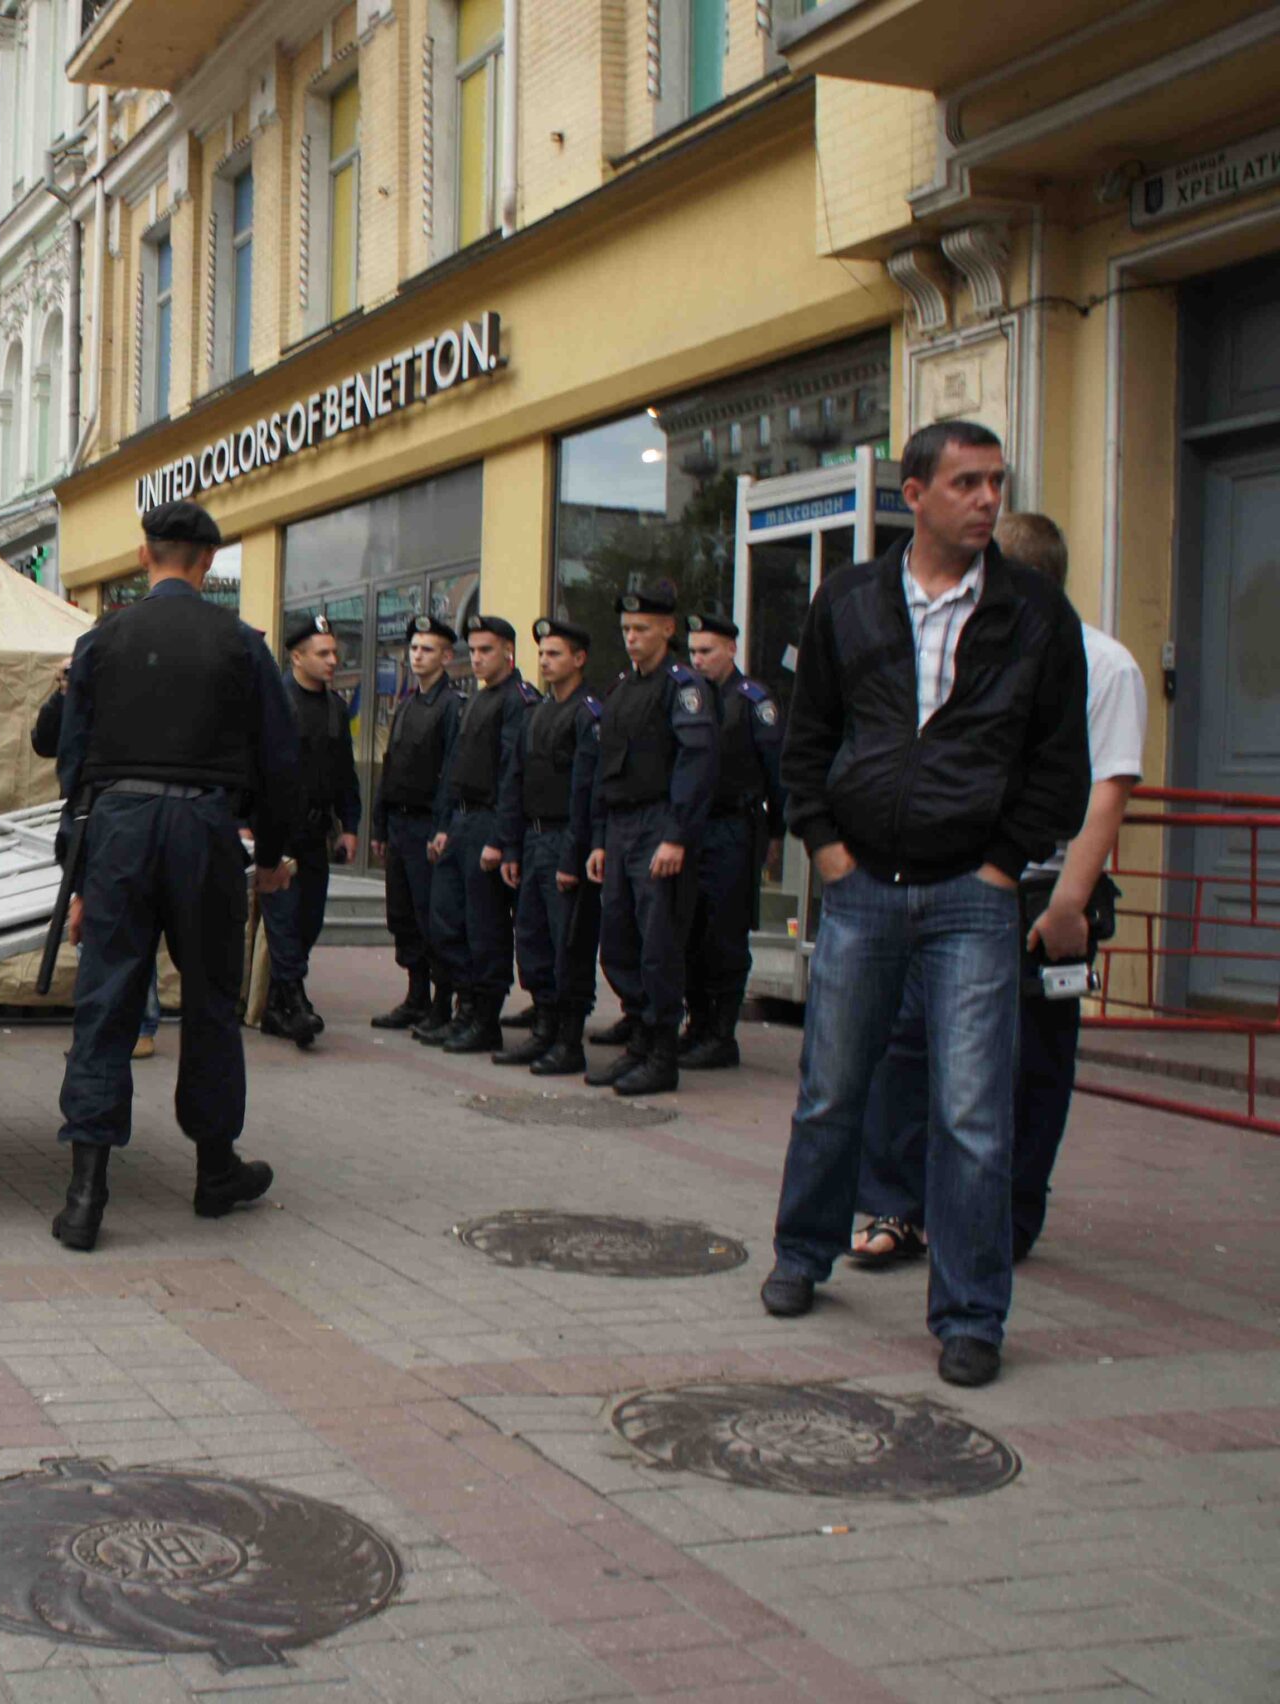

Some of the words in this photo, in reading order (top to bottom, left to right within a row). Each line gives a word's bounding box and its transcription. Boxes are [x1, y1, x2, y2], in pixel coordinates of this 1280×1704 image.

[135, 455, 197, 518] UNITED
[199, 411, 282, 490] COLORS
[286, 392, 320, 453] OF
